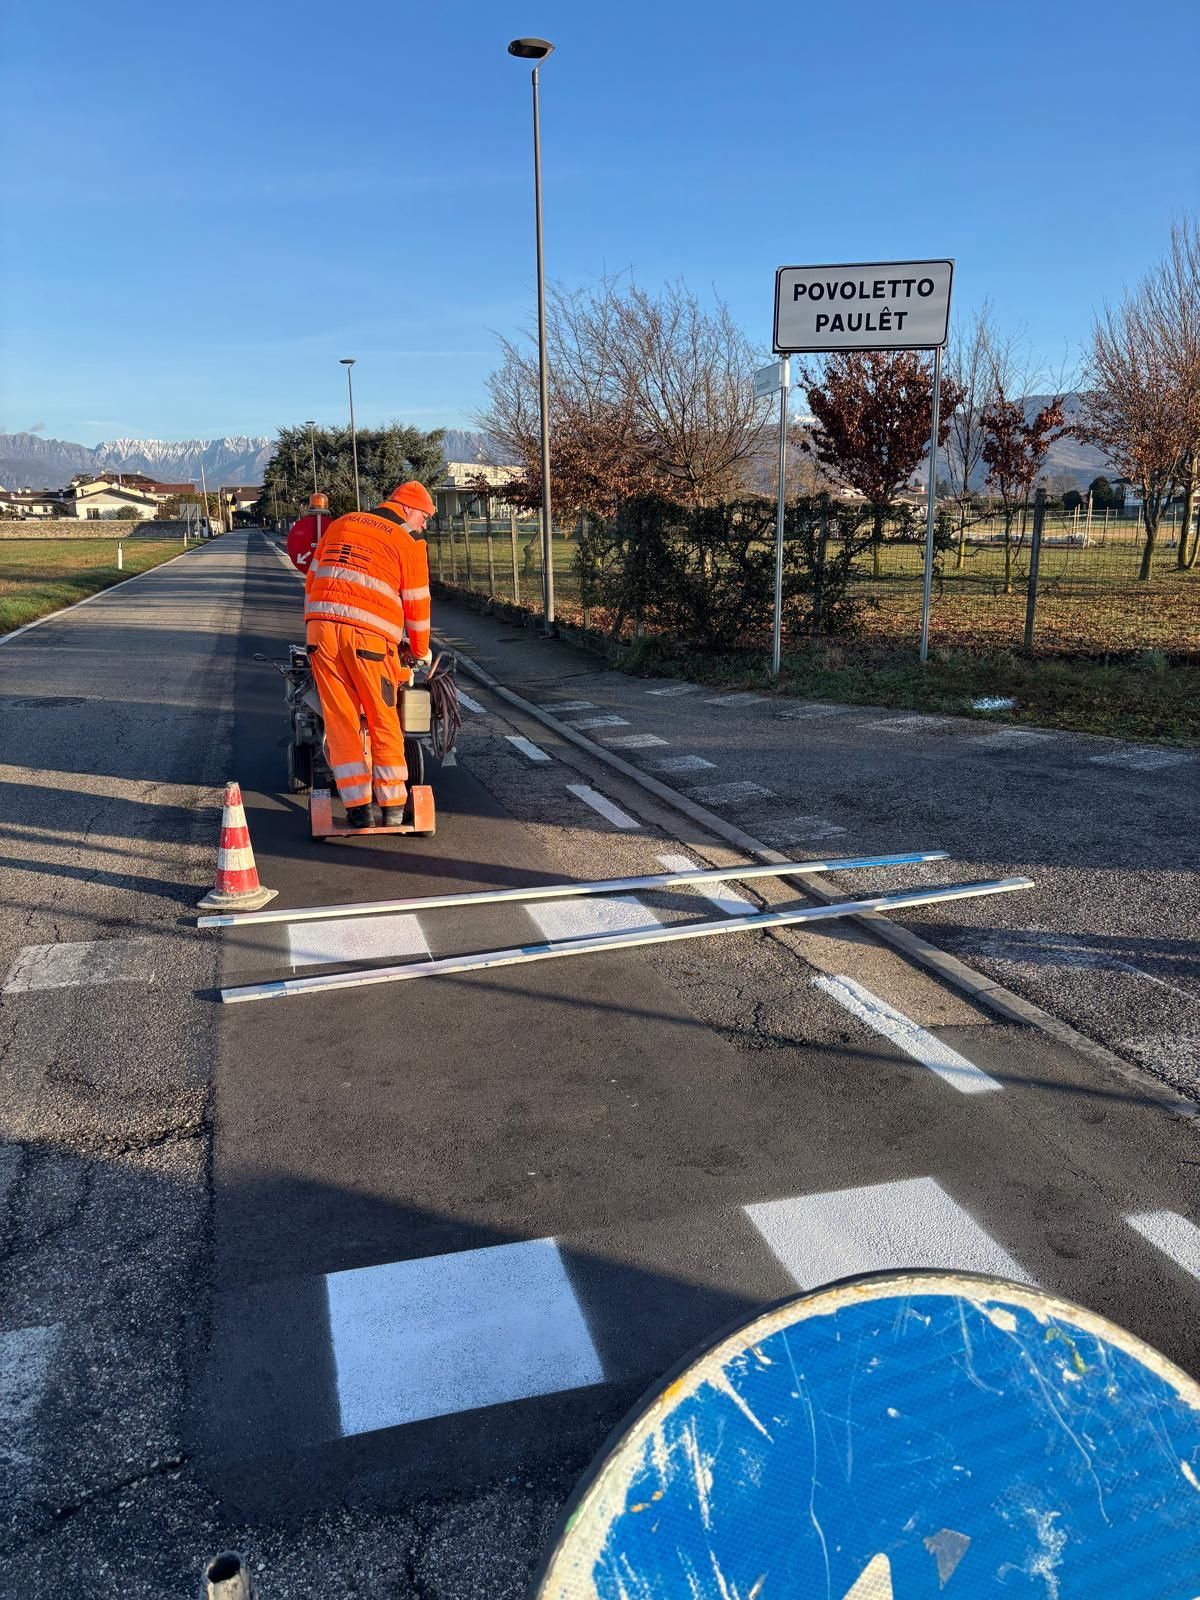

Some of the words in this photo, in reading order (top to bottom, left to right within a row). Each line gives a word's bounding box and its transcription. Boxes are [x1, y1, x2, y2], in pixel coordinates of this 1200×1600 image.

[793, 278, 935, 302] POVOLETTO
[815, 306, 908, 333] PAULÊT
[360, 517, 393, 535] ISONTINA
